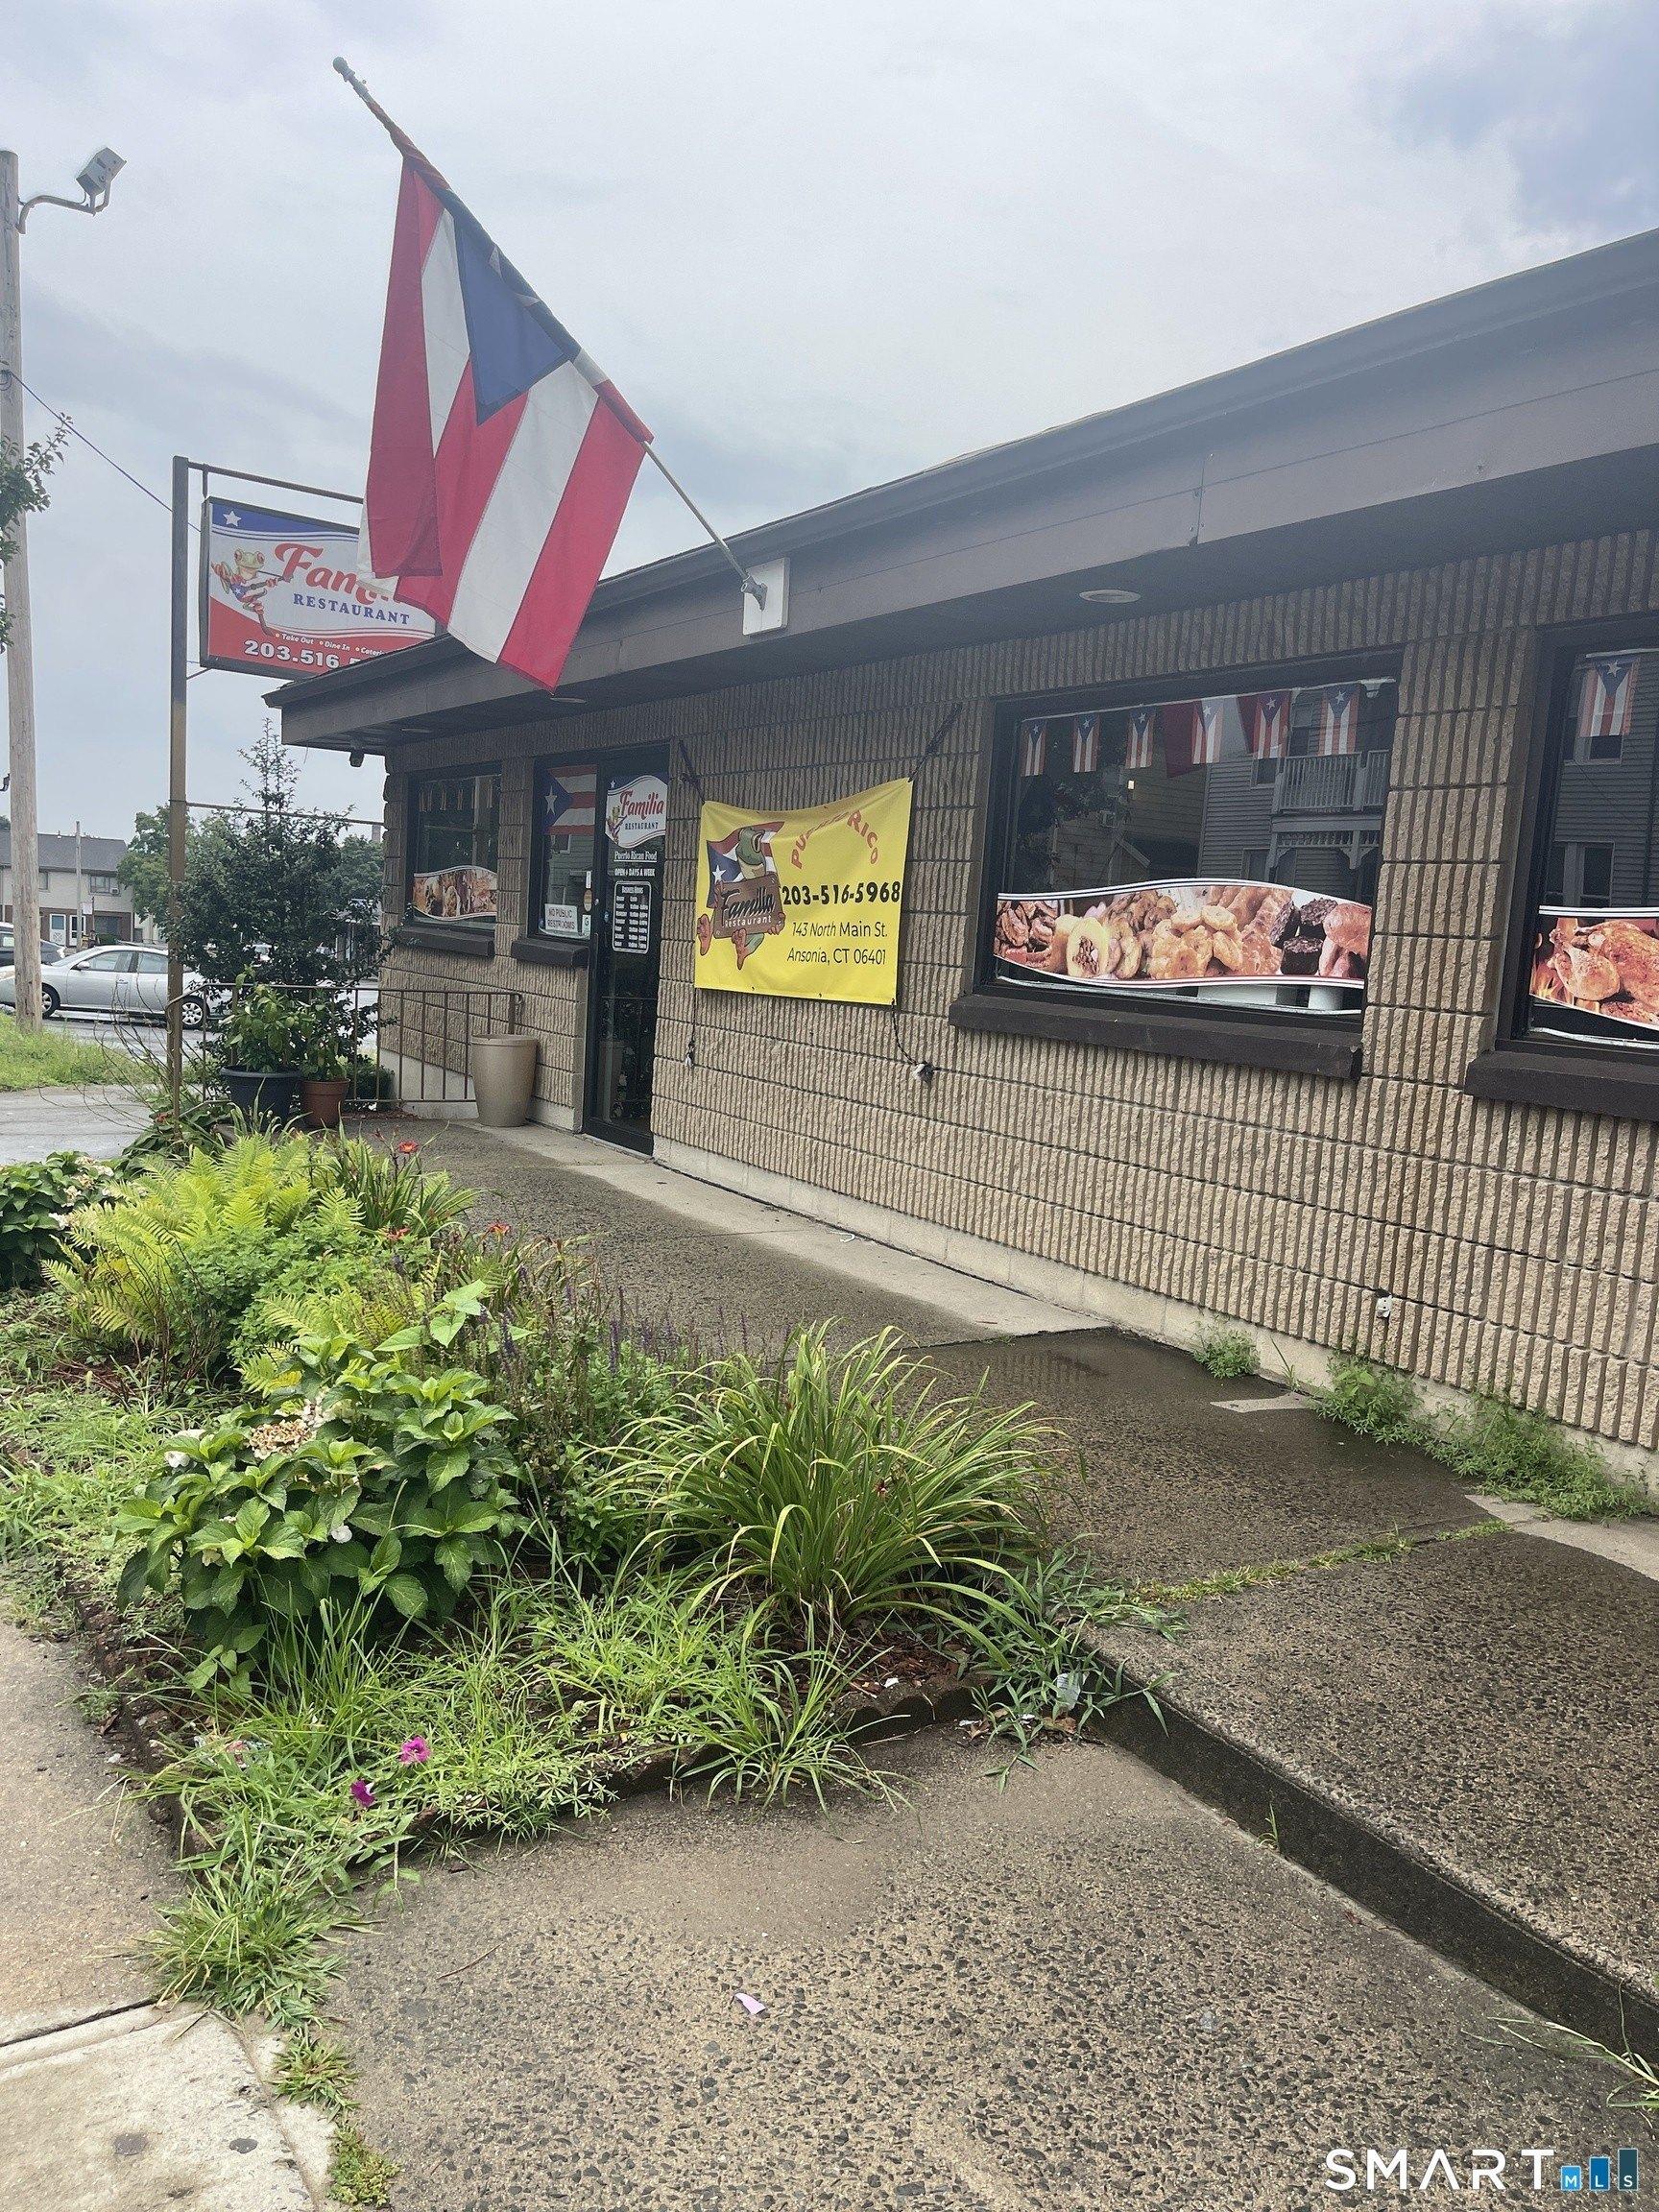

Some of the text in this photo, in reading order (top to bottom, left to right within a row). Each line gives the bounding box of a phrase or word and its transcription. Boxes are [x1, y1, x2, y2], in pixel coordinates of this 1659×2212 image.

[293, 593, 410, 624] RESTAURANT
[281, 633, 300, 642] Take
[301, 636, 314, 645] Out
[325, 640, 341, 650] Dine
[620, 789, 665, 821] Familia
[847, 810, 878, 865] RICO
[781, 880, 902, 905] 203-516-5968
[721, 887, 776, 927] Familia
[792, 922, 888, 937] 143 North Main St.
[787, 948, 886, 965] Ansonia, CT 06401
